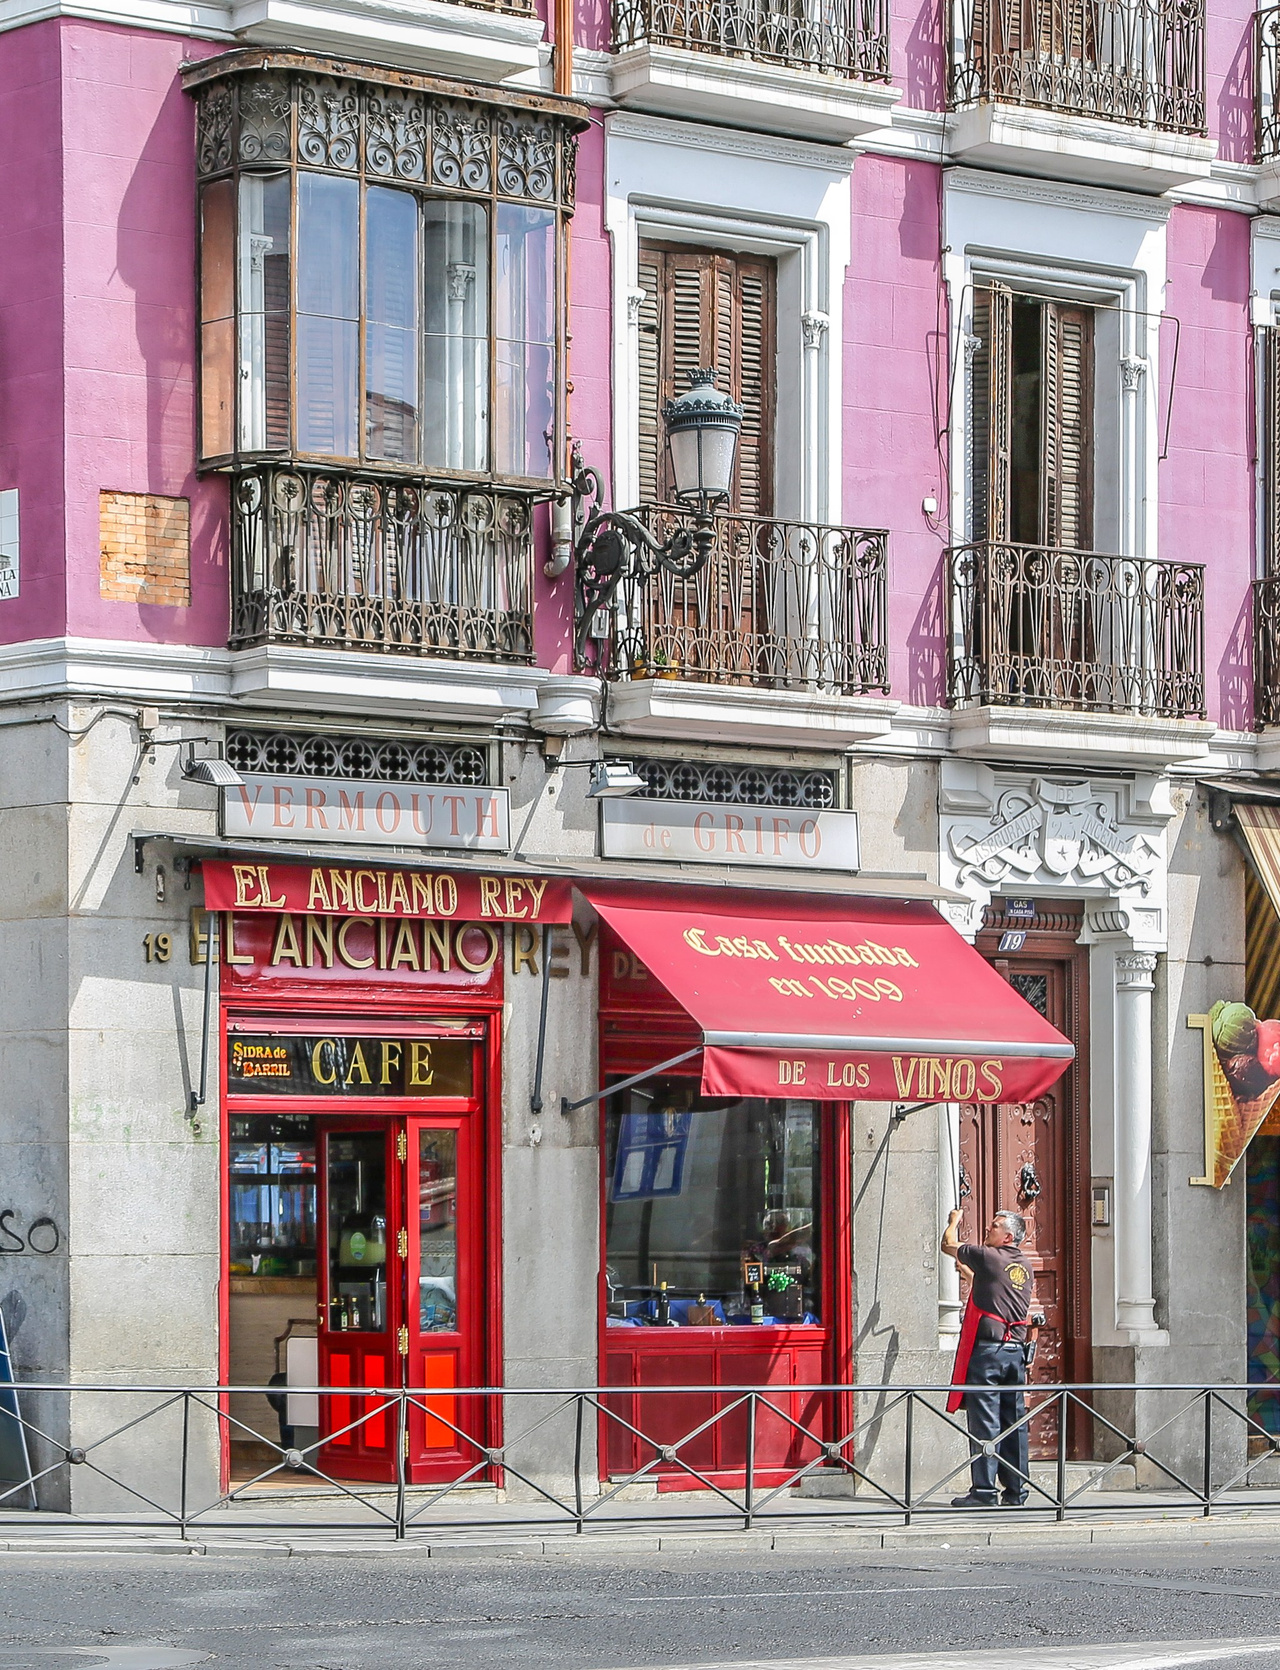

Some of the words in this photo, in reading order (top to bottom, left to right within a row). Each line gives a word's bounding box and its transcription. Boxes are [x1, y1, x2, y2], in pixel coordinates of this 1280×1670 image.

[4, 569, 16, 581] LA
[238, 784, 501, 838] VERMOUTH
[642, 822, 672, 849] de
[693, 811, 823, 859] GRIFO
[974, 810, 1041, 863] ASEGURADA
[232, 864, 287, 908] EL
[307, 867, 458, 916] ANCIANO
[479, 876, 549, 919] REY
[1013, 900, 1028, 909] GAS
[144, 932, 173, 962] 19
[190, 907, 255, 966] EL
[272, 912, 499, 974] ANCIANO
[512, 920, 598, 977] REY
[682, 927, 780, 962] Casa
[776, 935, 920, 968] fundada
[1002, 934, 1022, 950] 19
[768, 975, 815, 999] en
[808, 974, 904, 1003] 1909
[233, 1041, 273, 1059] SIDRA
[273, 1046, 287, 1059] de
[242, 1061, 291, 1077] BARRIL
[311, 1038, 435, 1086] CAFE
[777, 1060, 807, 1086] DE
[827, 1061, 871, 1089] LOS
[891, 1056, 1004, 1101] VINOS
